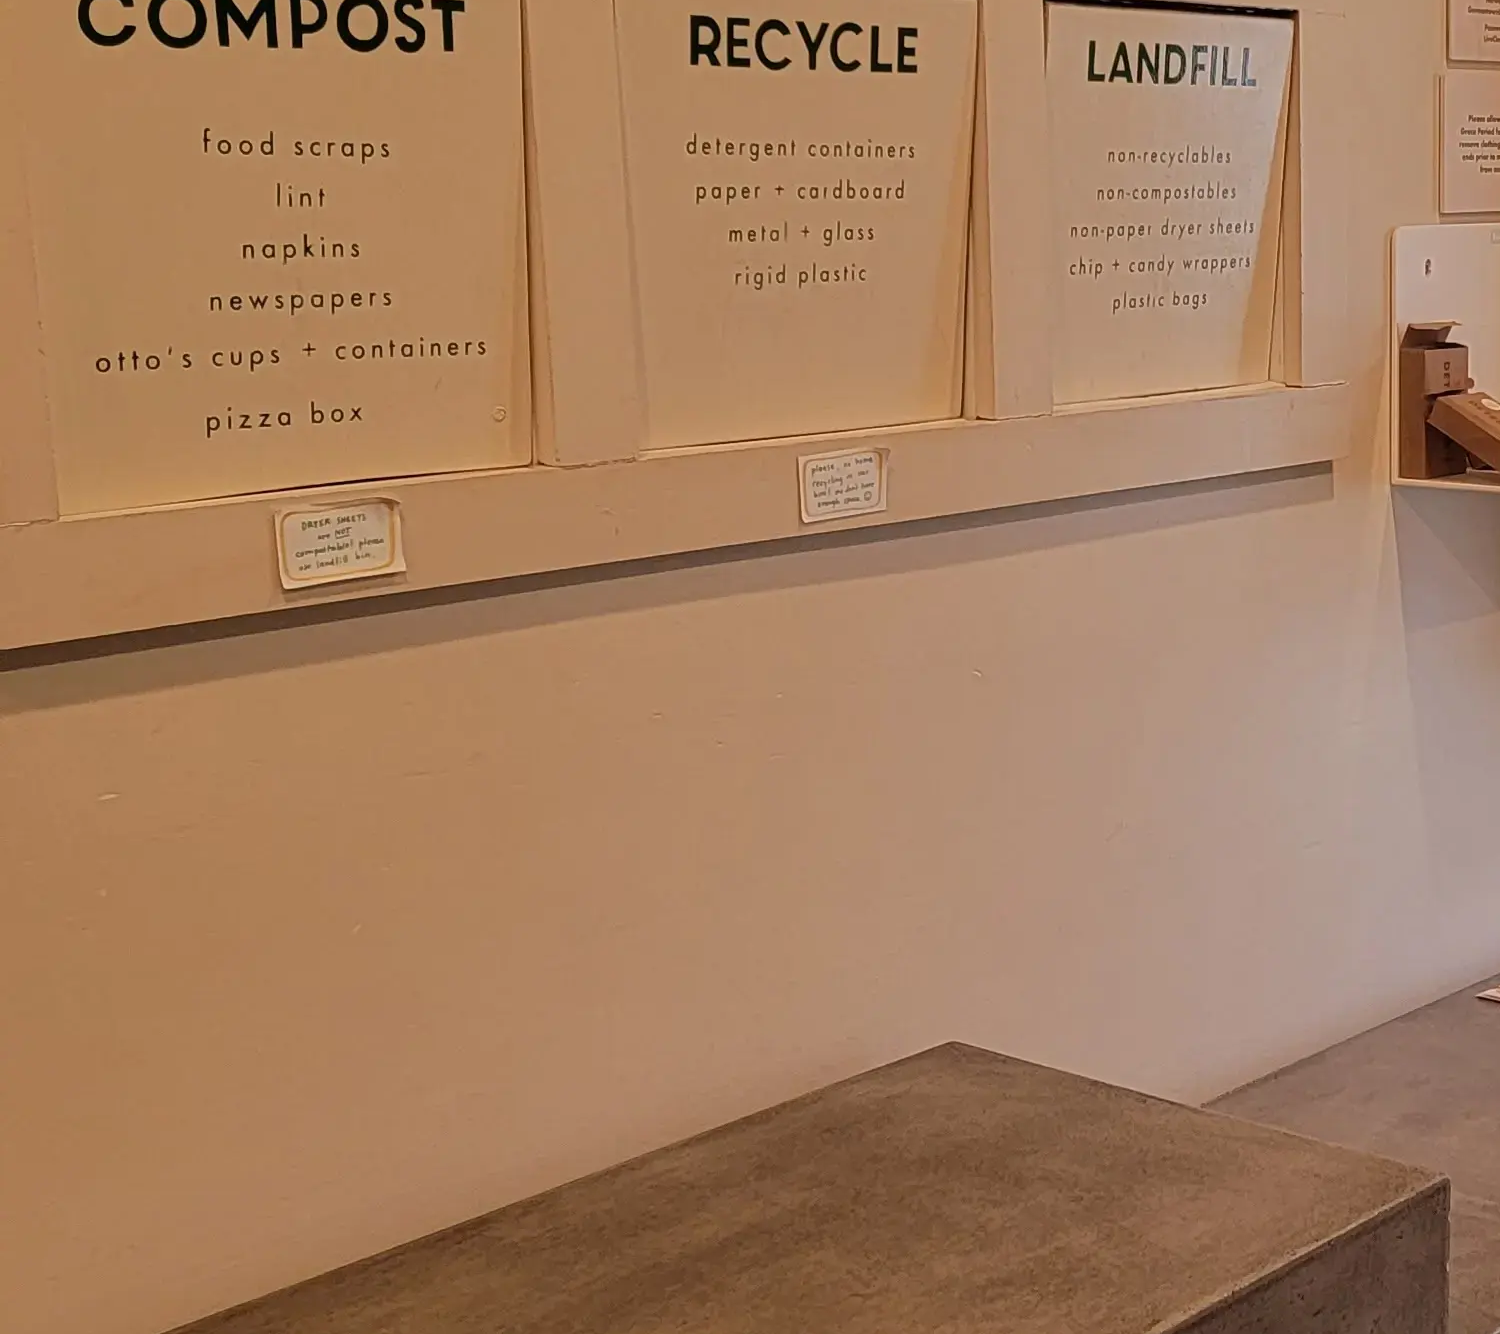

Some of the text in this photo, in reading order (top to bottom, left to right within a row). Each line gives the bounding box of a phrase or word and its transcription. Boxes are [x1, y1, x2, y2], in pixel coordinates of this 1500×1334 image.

[689, 14, 918, 74] RECYCLE
[1087, 40, 1257, 87] LANDFILL
[202, 127, 390, 165] food scraps
[686, 132, 915, 162] detergent containers
[1107, 145, 1231, 168] non-recyclables
[276, 182, 325, 208] lint
[695, 178, 905, 206] paper + cardboard
[1097, 181, 1236, 205] non-compostables
[728, 220, 874, 247] metal + glass
[1070, 217, 1254, 242] non-paper dryer sheets
[242, 233, 360, 264] napkins
[735, 262, 867, 291] rigid plastic
[1069, 254, 1251, 280] chip + candy wrappers
[210, 292, 392, 316] newspapers
[1112, 290, 1207, 315] plastic bags
[95, 336, 486, 373] otto's cups + containers
[206, 401, 362, 439] pizza box
[301, 513, 366, 531] DRYER SHEETS
[335, 527, 352, 538] NOT
